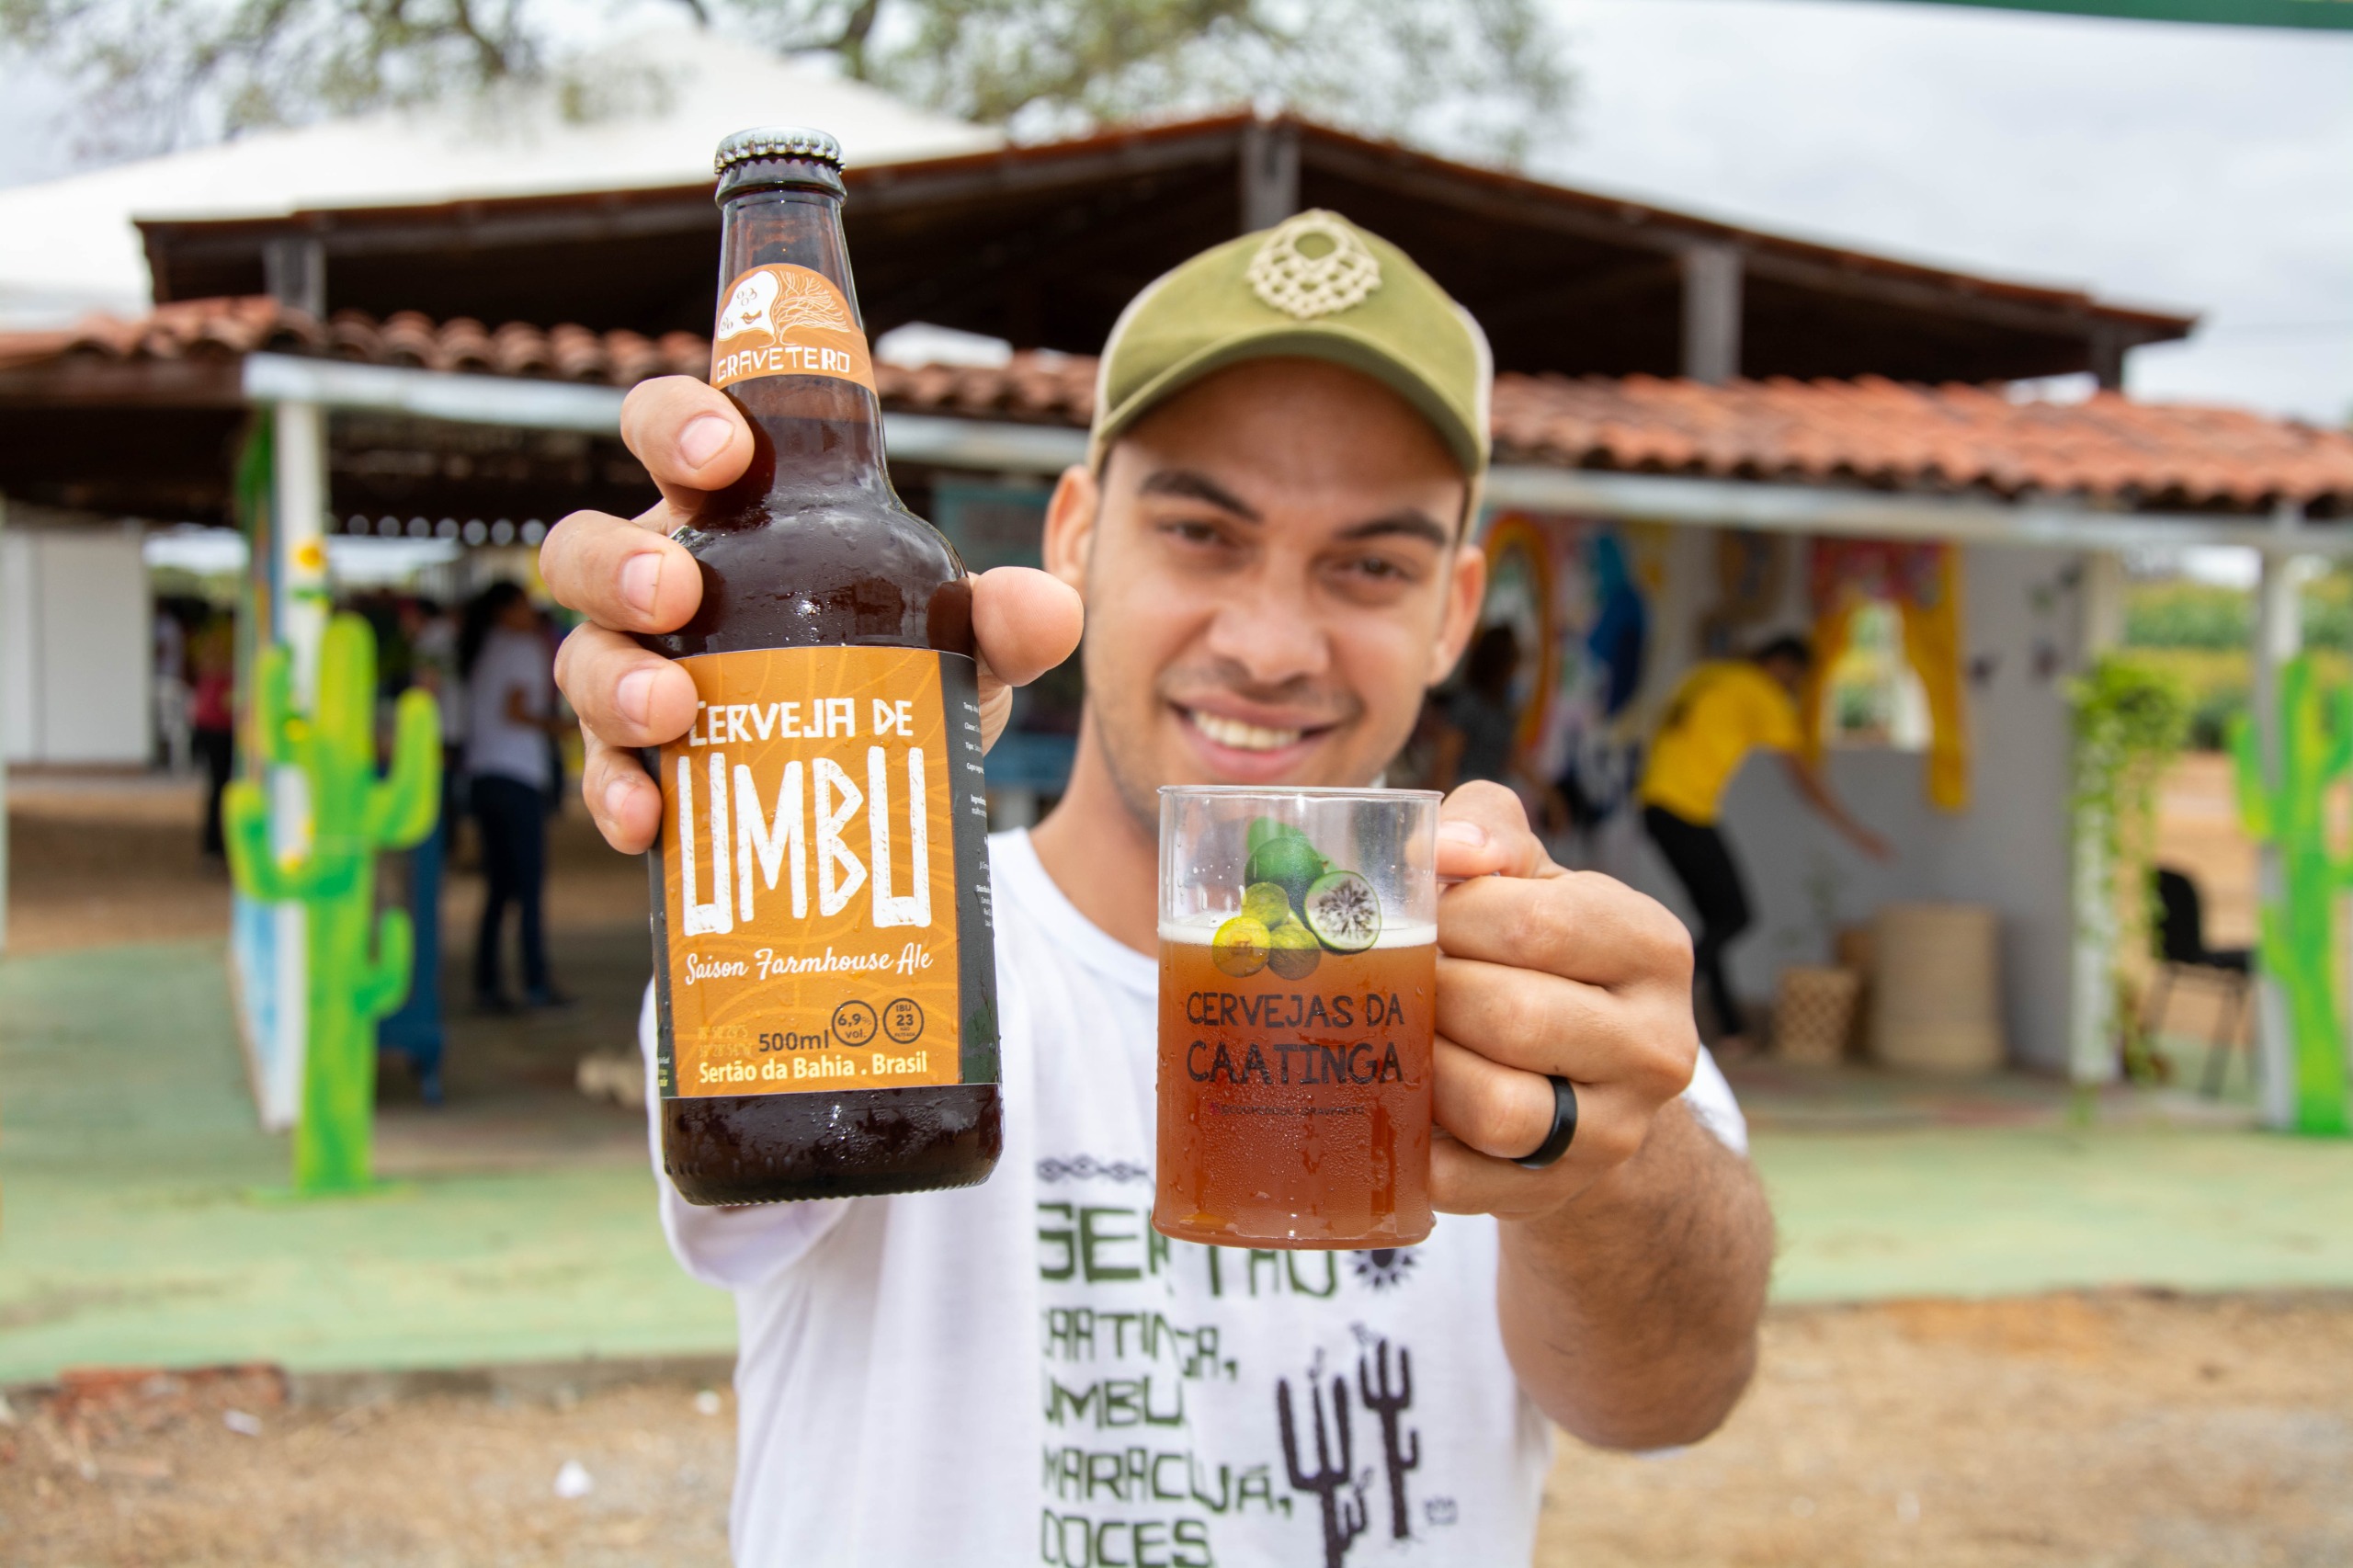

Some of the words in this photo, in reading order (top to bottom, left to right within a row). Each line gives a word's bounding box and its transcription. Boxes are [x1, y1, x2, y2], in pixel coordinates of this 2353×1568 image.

[717, 347, 850, 383] GRAVETERO
[872, 699, 914, 736] DE
[677, 745, 931, 937] UMBU
[685, 953, 749, 985] Saison
[755, 947, 894, 980] Farmhouse
[896, 942, 934, 975] Ale
[895, 1004, 912, 1012] IBU
[896, 1014, 914, 1027] 23
[1187, 992, 1354, 1028] CERVEJAS
[1366, 993, 1404, 1027] DA
[758, 1029, 830, 1052] 500ml
[845, 1028, 867, 1039] vol.
[699, 1060, 756, 1084] Sertão
[761, 1059, 788, 1081] da
[793, 1054, 855, 1079] Bahia
[872, 1051, 927, 1075] Brasil
[1187, 1040, 1404, 1085] CAATINGA
